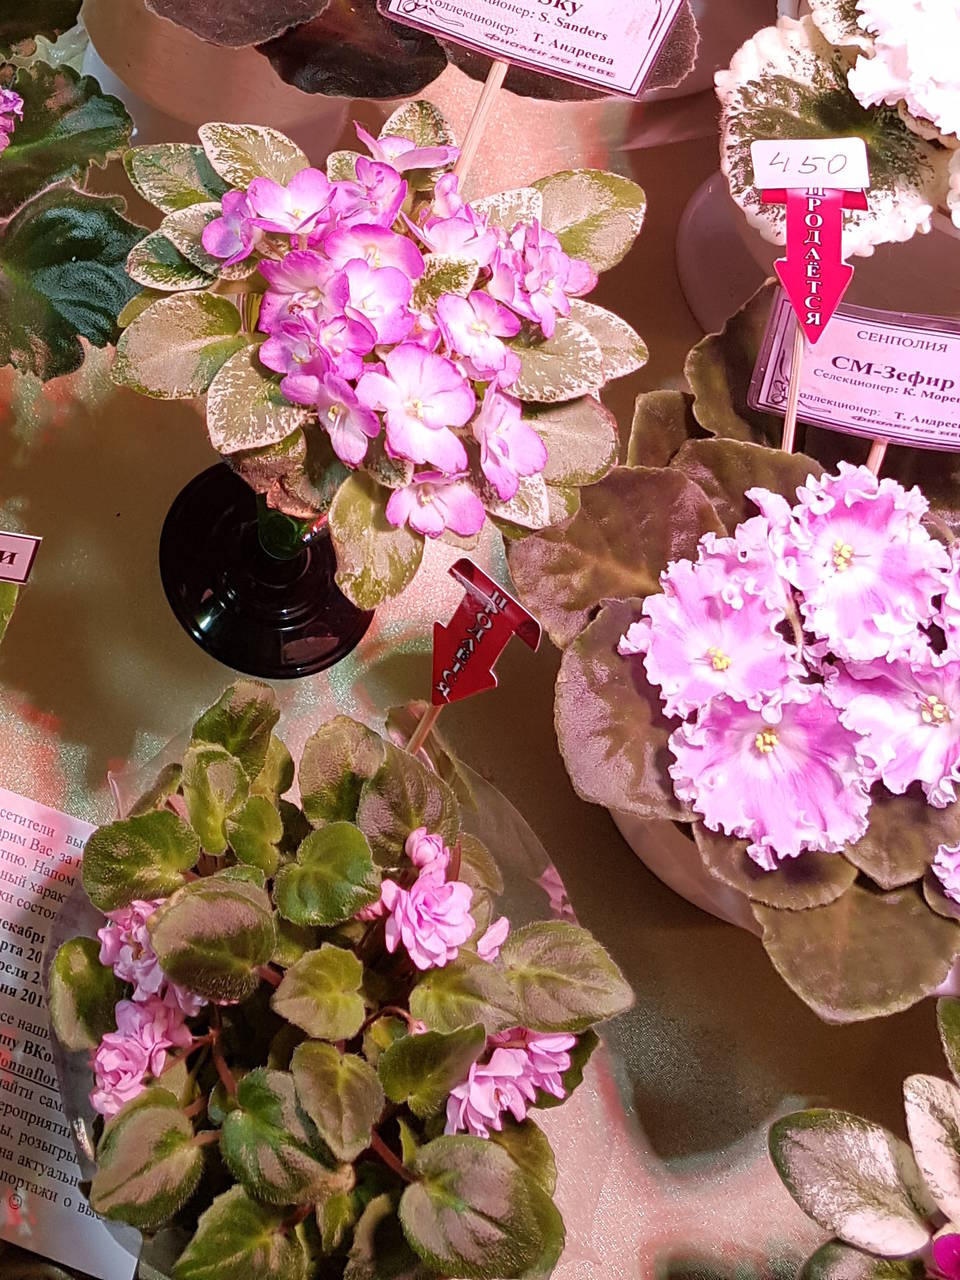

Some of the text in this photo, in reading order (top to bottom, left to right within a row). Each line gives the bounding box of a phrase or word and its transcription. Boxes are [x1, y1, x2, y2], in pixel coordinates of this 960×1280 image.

[537, 11, 552, 25] S.
[553, 17, 609, 42] Sanders
[532, 31, 545, 45] Т.
[548, 38, 615, 68] Андреева
[768, 151, 848, 176] 450
[803, 187, 824, 327] ПРОДАЁТСЯ
[856, 329, 949, 353] СЕНПОЛИЯ
[812, 368, 900, 394] Селекционер:
[902, 387, 917, 397] К.
[830, 355, 956, 392] СМ-Зефир
[798, 392, 882, 417] оллекционер:
[894, 411, 906, 422] Т.
[29, 837, 56, 861] Вас,
[58, 852, 73, 866] за
[19, 987, 47, 1009] 201
[22, 1040, 56, 1065] ВКо
[17, 1131, 78, 1165] розыгры
[62, 1195, 73, 1209] о
